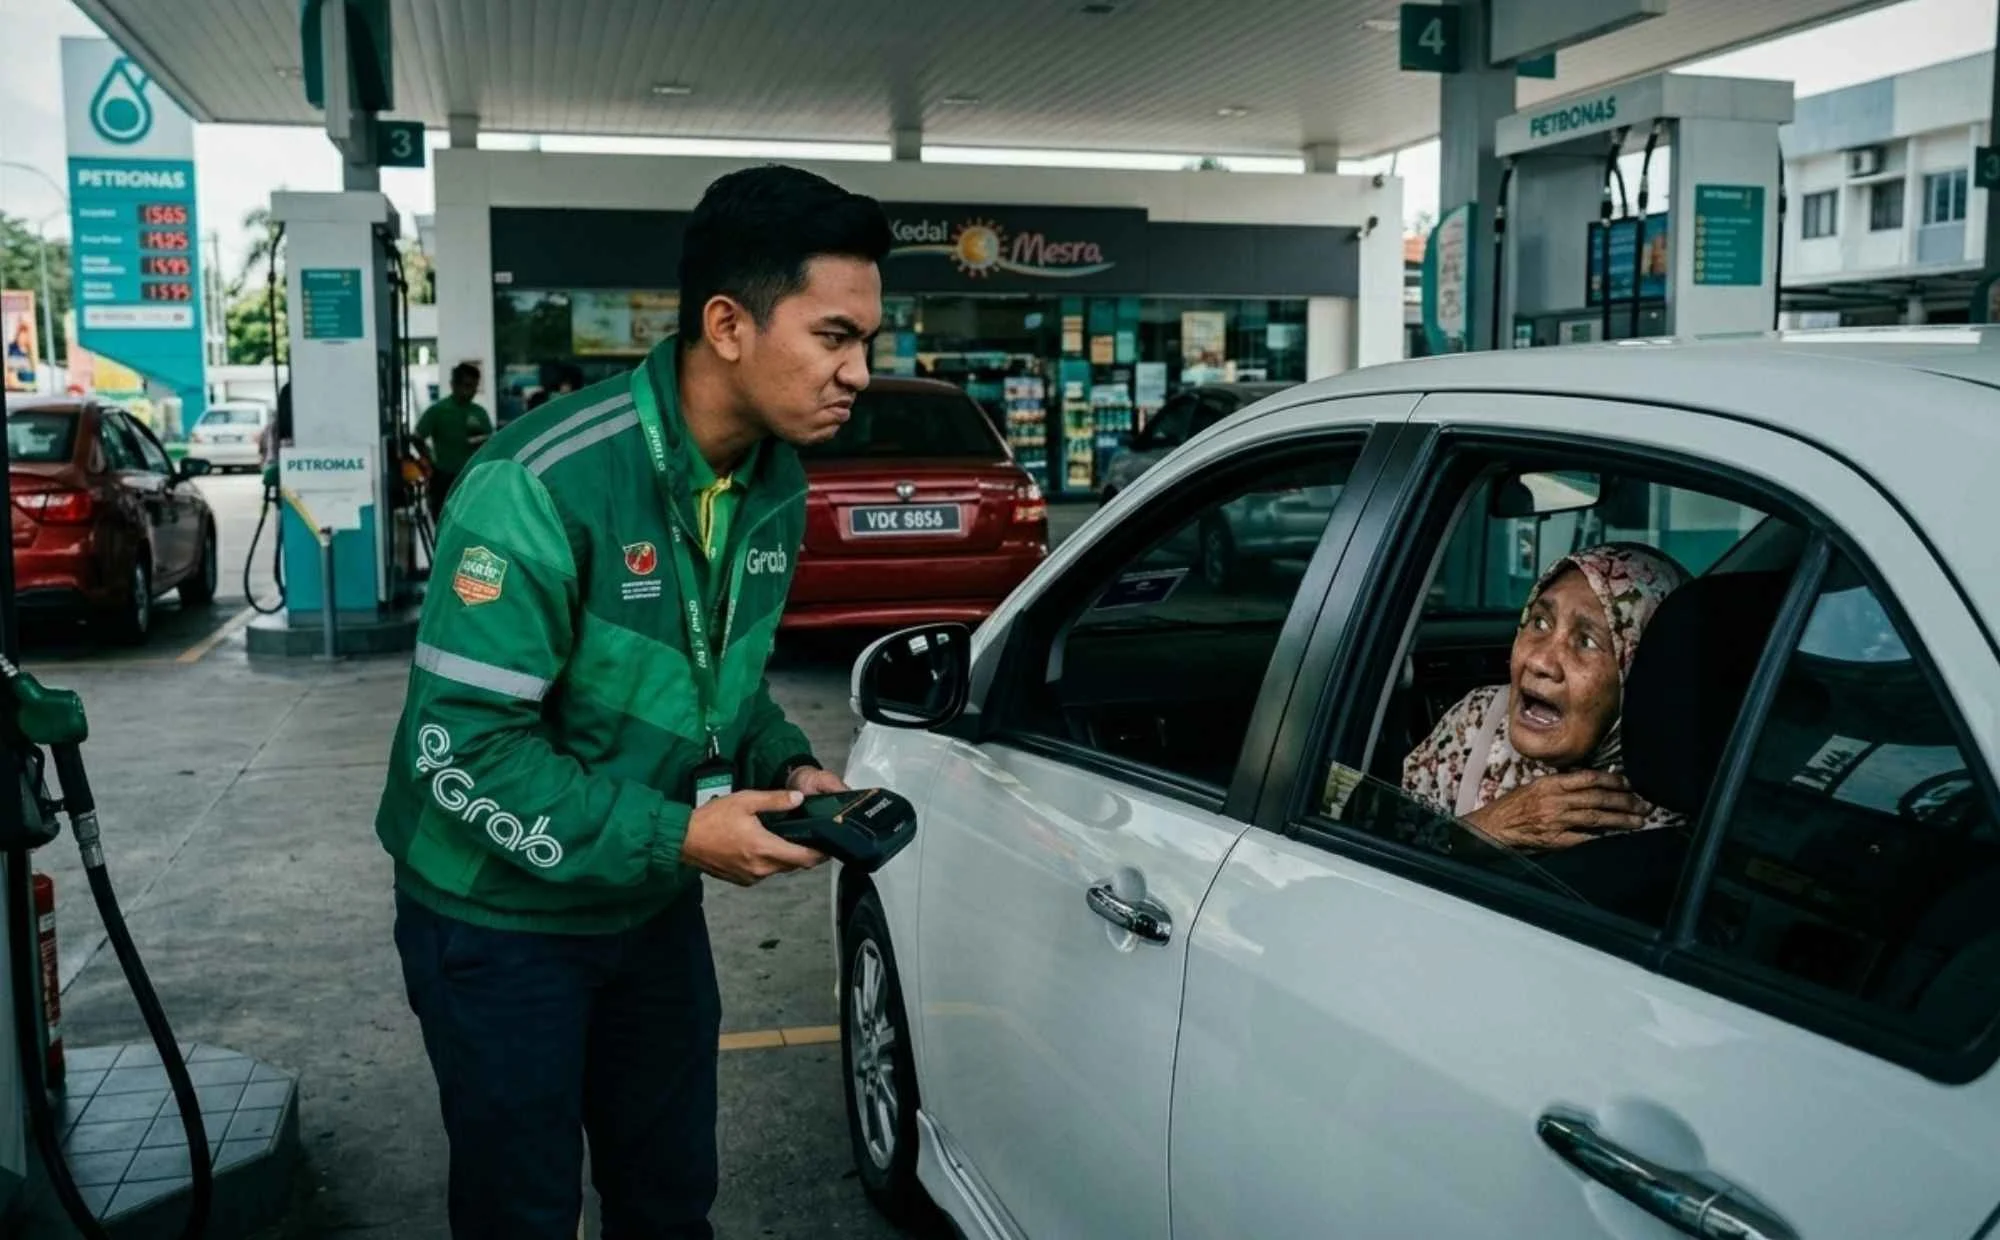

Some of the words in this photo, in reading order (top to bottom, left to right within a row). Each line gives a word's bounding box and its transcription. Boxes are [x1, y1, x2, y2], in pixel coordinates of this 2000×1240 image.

[1418, 17, 1446, 55] 4
[391, 129, 412, 158] 3
[78, 168, 187, 189] PETRONAS
[1011, 231, 1103, 265] Mesra
[746, 542, 788, 575] Grab
[432, 768, 563, 868] Grab
